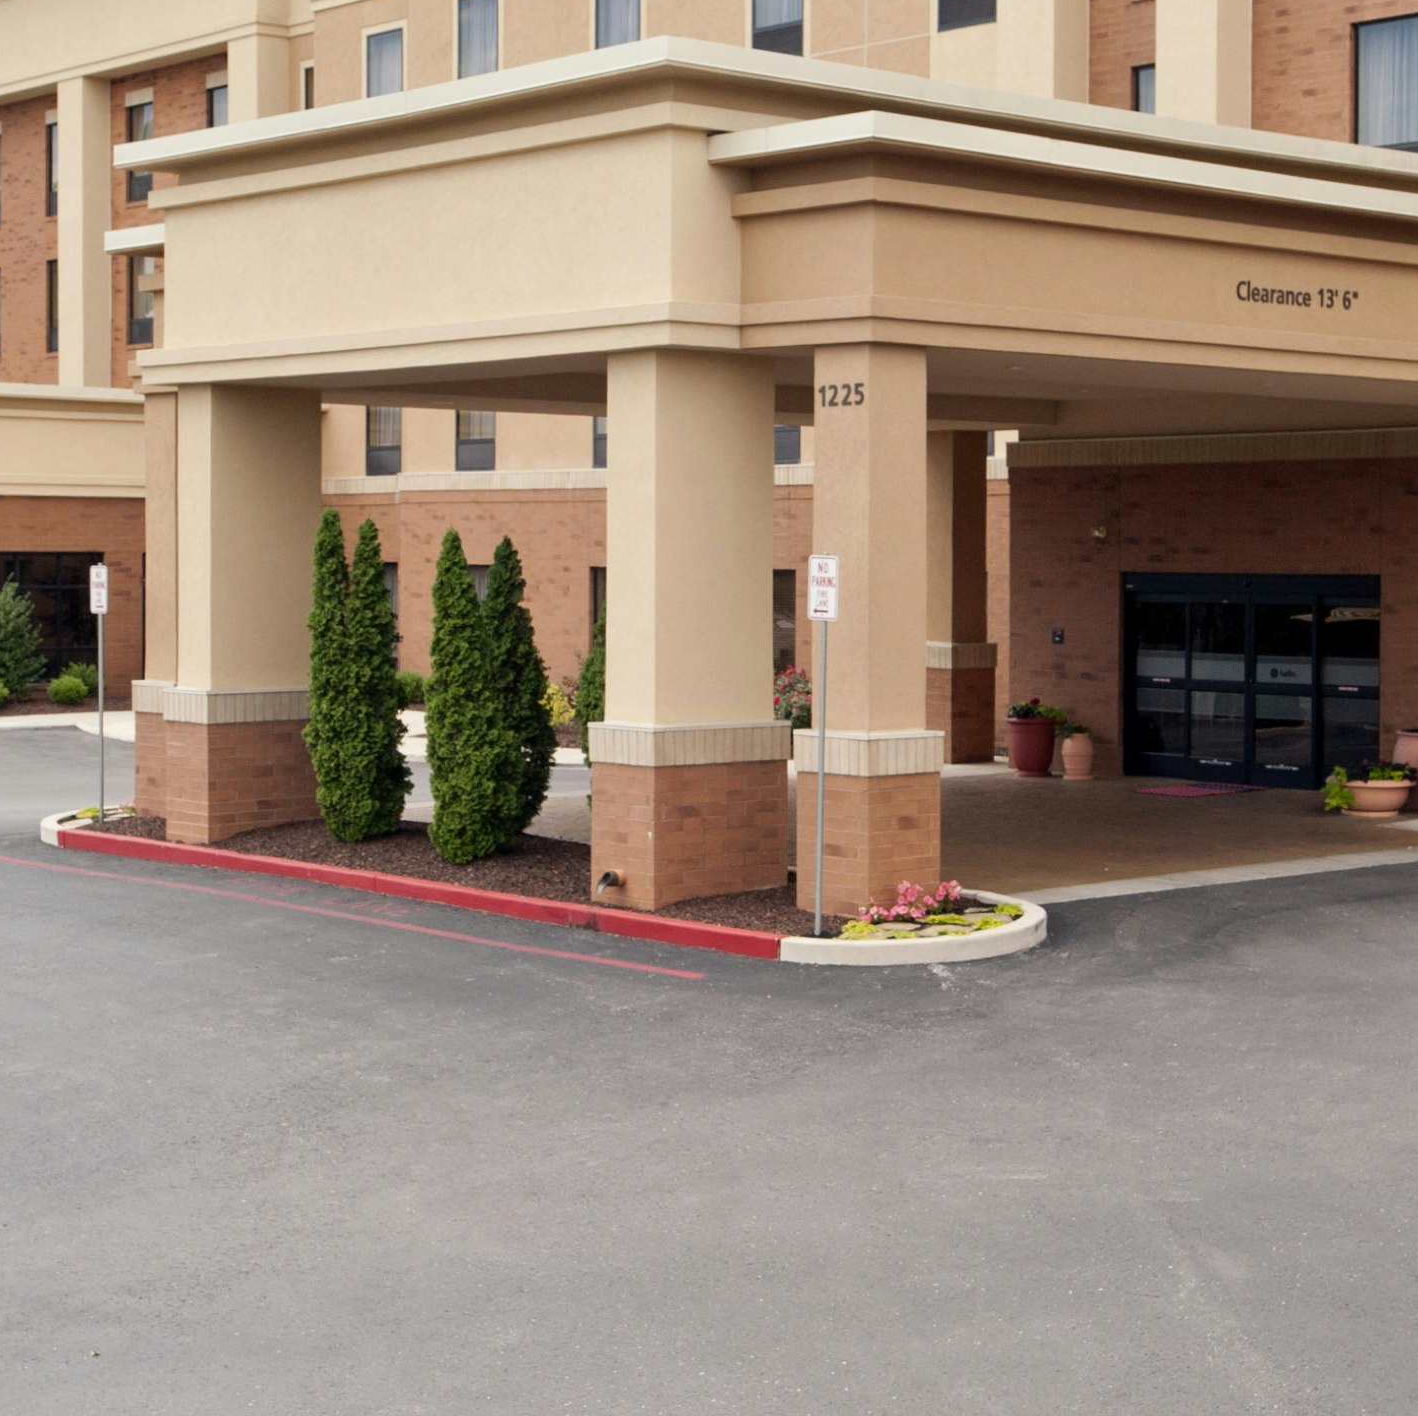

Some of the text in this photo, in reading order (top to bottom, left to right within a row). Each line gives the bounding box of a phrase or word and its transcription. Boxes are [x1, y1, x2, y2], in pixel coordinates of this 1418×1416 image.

[1236, 280, 1311, 307] Clearance
[1317, 288, 1338, 308] 13'
[818, 383, 865, 407] 1225
[817, 562, 829, 574] NO
[811, 575, 836, 588] PARKING
